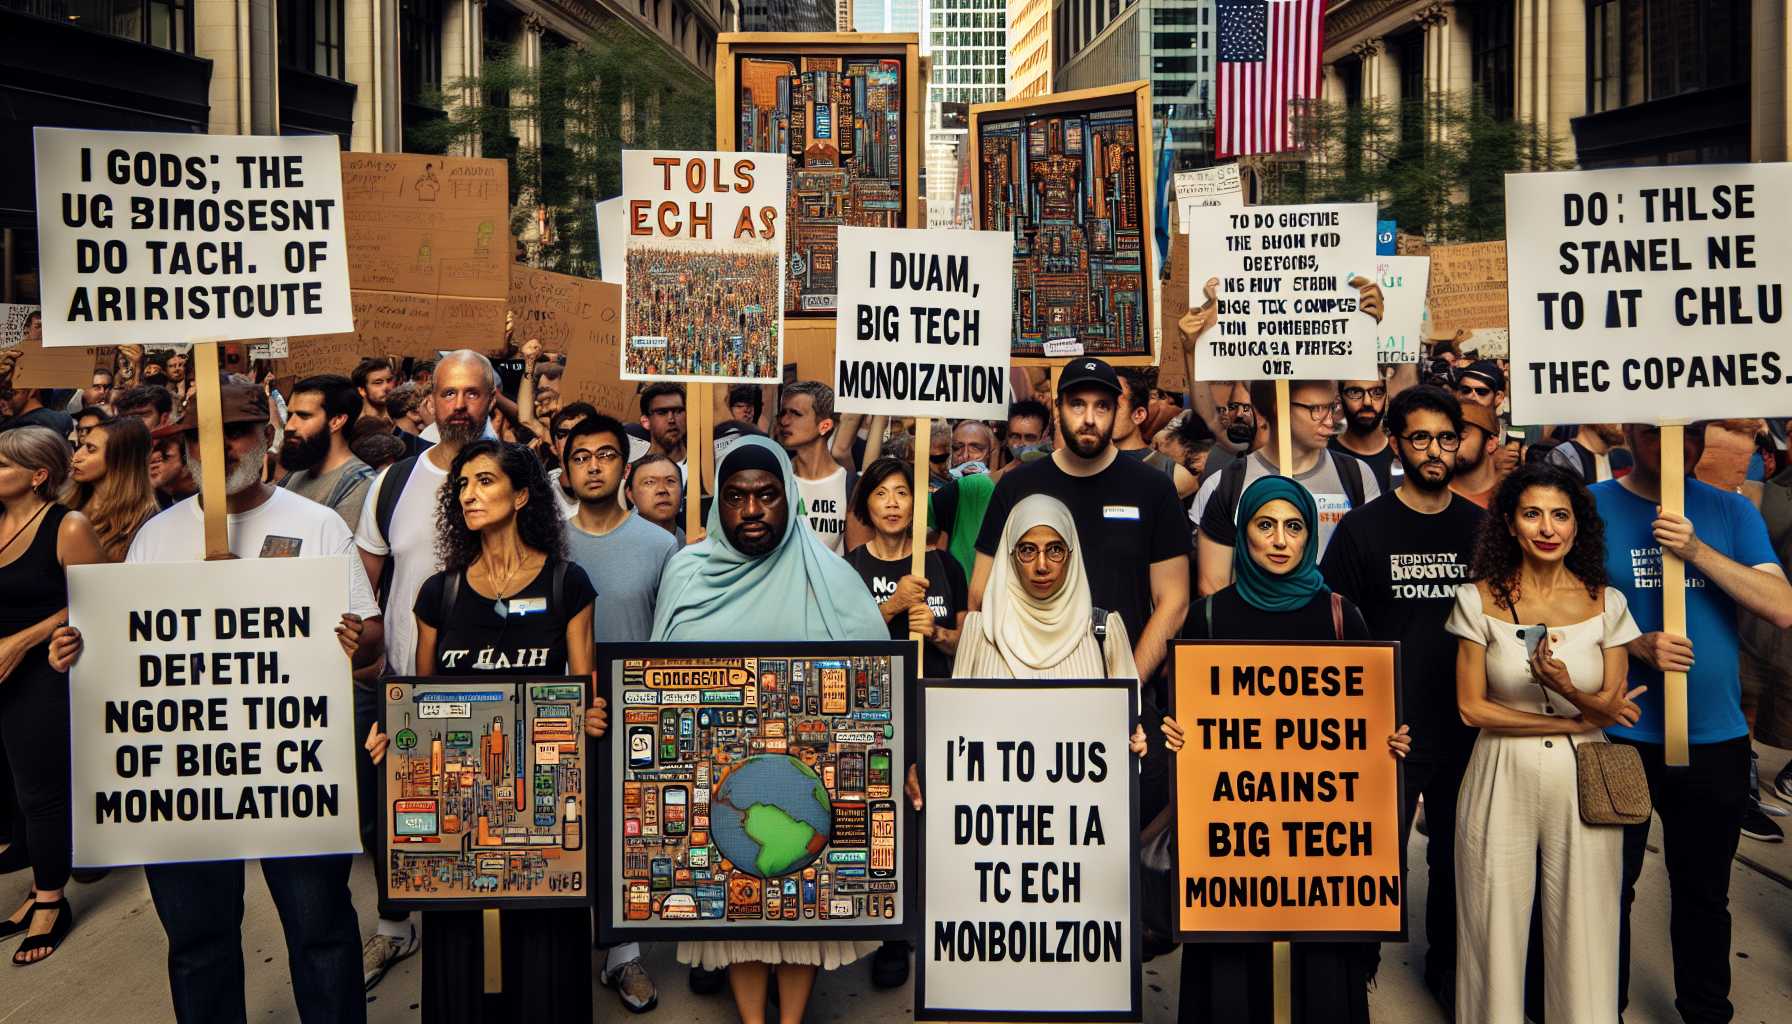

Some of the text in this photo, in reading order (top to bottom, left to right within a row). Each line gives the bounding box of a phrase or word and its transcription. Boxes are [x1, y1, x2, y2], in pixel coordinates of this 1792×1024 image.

[81, 148, 91, 182] I
[236, 156, 303, 188] THE
[653, 157, 755, 193] TOLS
[630, 200, 777, 240] ECH AS
[1254, 214, 1274, 228] DO
[1640, 185, 1754, 222] THLSE
[77, 239, 327, 275] DO TACH. OF
[1560, 235, 1756, 274] STANEL NE
[870, 251, 979, 298] I DUAM,
[67, 282, 322, 321] ARIRISTOUTE
[1538, 291, 1584, 330] TO
[857, 304, 979, 346] BIG TECH
[839, 360, 1003, 404] MONOIZATION
[1529, 360, 1610, 394] THEC
[130, 607, 310, 641] NOT DERN
[1211, 666, 1363, 696] I MCOESE
[105, 696, 327, 734] NGORE TIOM
[1197, 718, 1366, 750] THE PUSH
[116, 740, 323, 778] OF BIGE CK
[997, 741, 1034, 782] TO
[1046, 742, 1107, 783] JUS
[96, 784, 338, 824] MONOILATION
[1213, 771, 1359, 802] AGAINST
[955, 804, 1054, 846] DOTHE
[1209, 822, 1372, 857] BIG TECH
[975, 862, 1080, 903] TC ECH
[1186, 875, 1399, 907] MONIOLIATION
